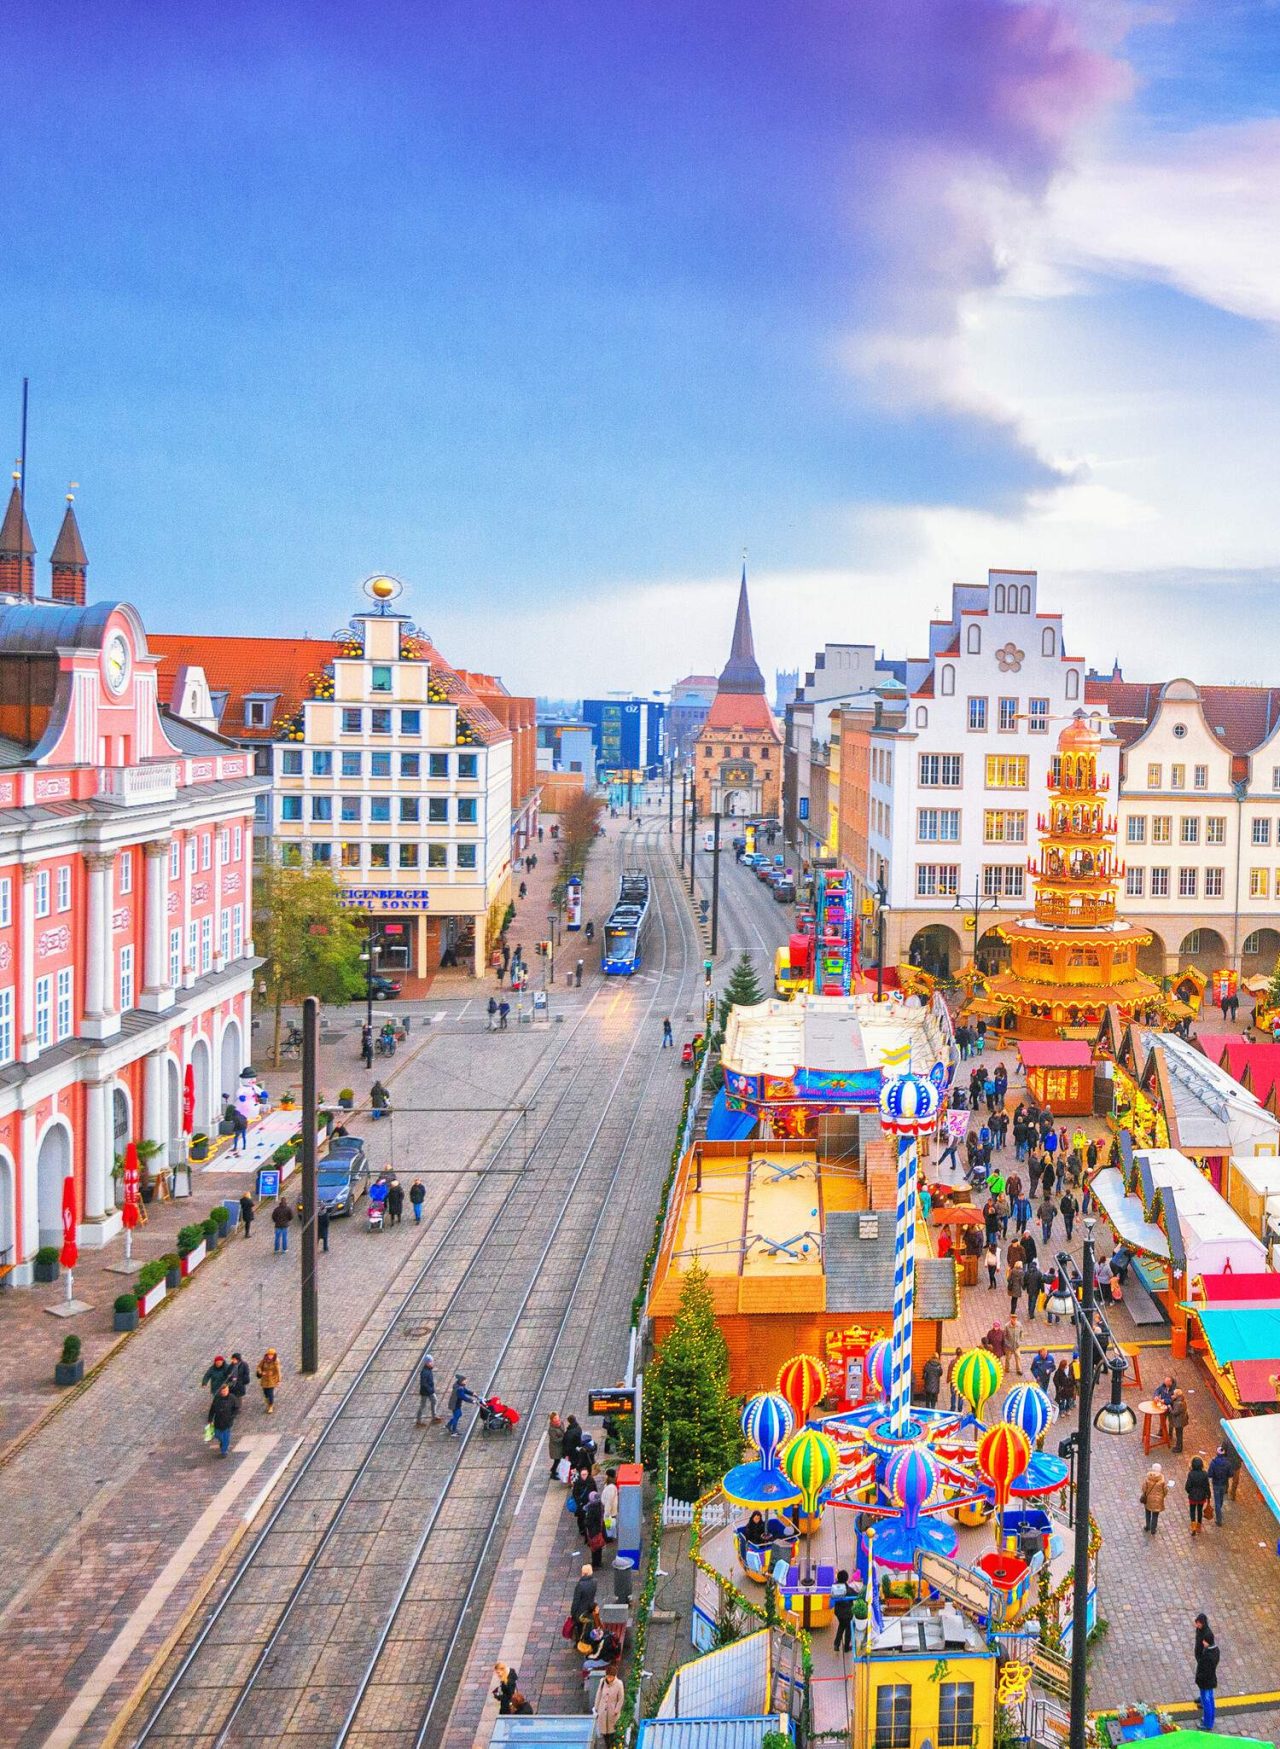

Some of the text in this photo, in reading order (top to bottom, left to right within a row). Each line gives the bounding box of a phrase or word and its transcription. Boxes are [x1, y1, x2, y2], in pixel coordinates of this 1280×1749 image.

[336, 889, 430, 899] EIGENBERGER
[382, 900, 430, 909] SONNE
[1032, 1655, 1067, 1680] EINGANG
